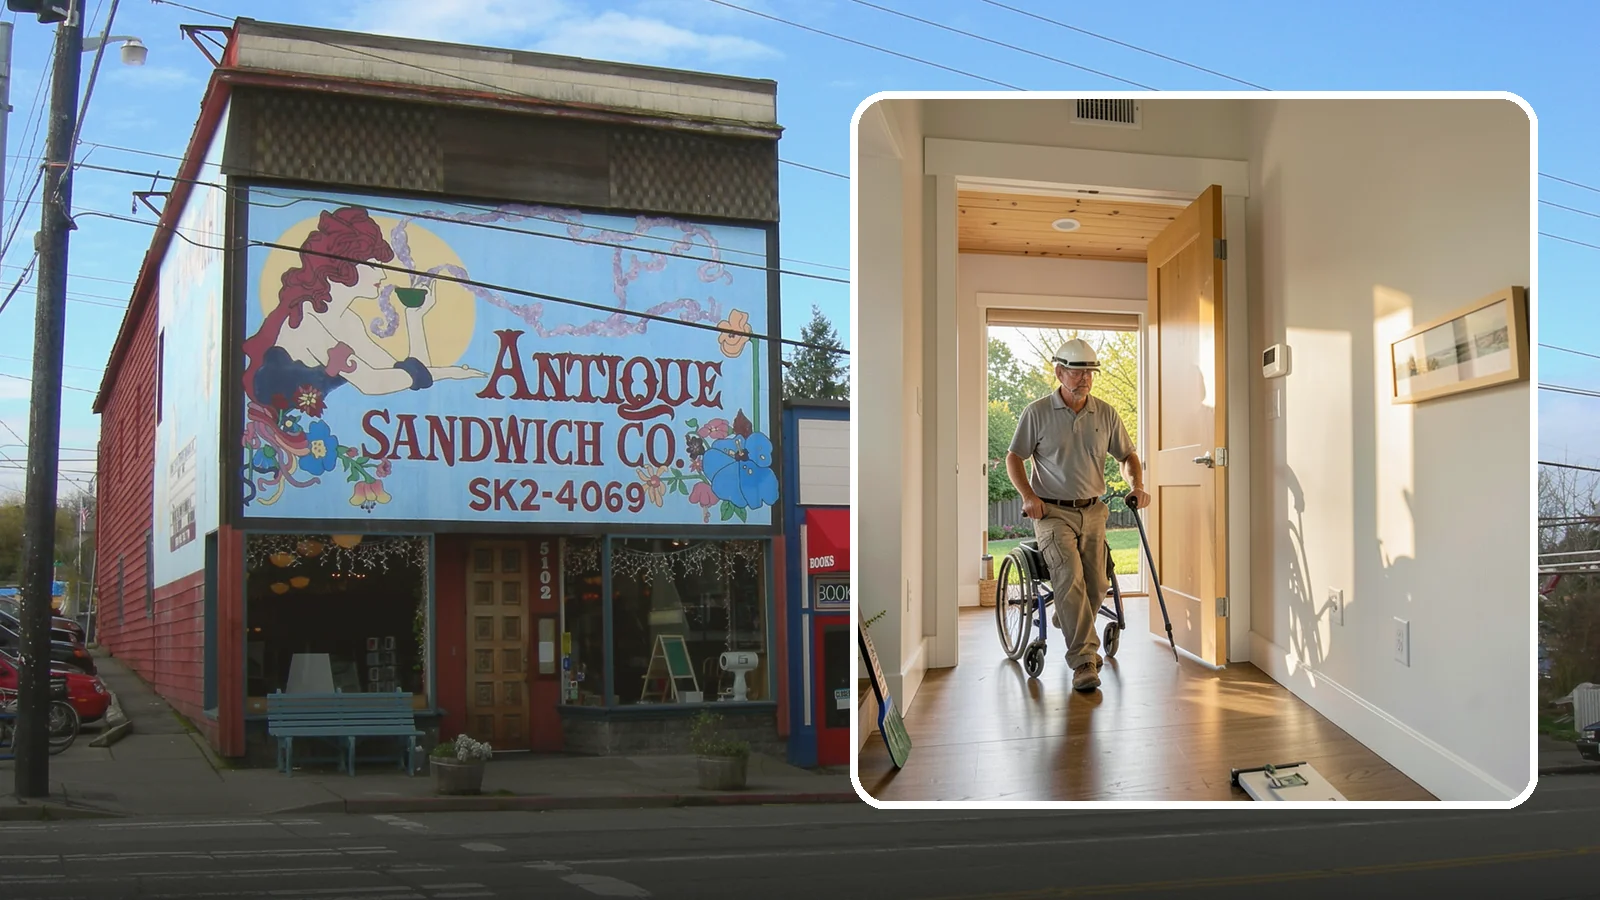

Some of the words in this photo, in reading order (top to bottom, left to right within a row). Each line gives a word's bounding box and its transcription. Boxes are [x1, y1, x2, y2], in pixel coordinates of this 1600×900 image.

[476, 328, 723, 421] ANTIQUE
[361, 408, 604, 467] SANDWICH
[617, 421, 685, 470] CO.
[468, 476, 646, 514] SK2-4069
[539, 541, 552, 600] 5102
[809, 555, 835, 569] BOOKS
